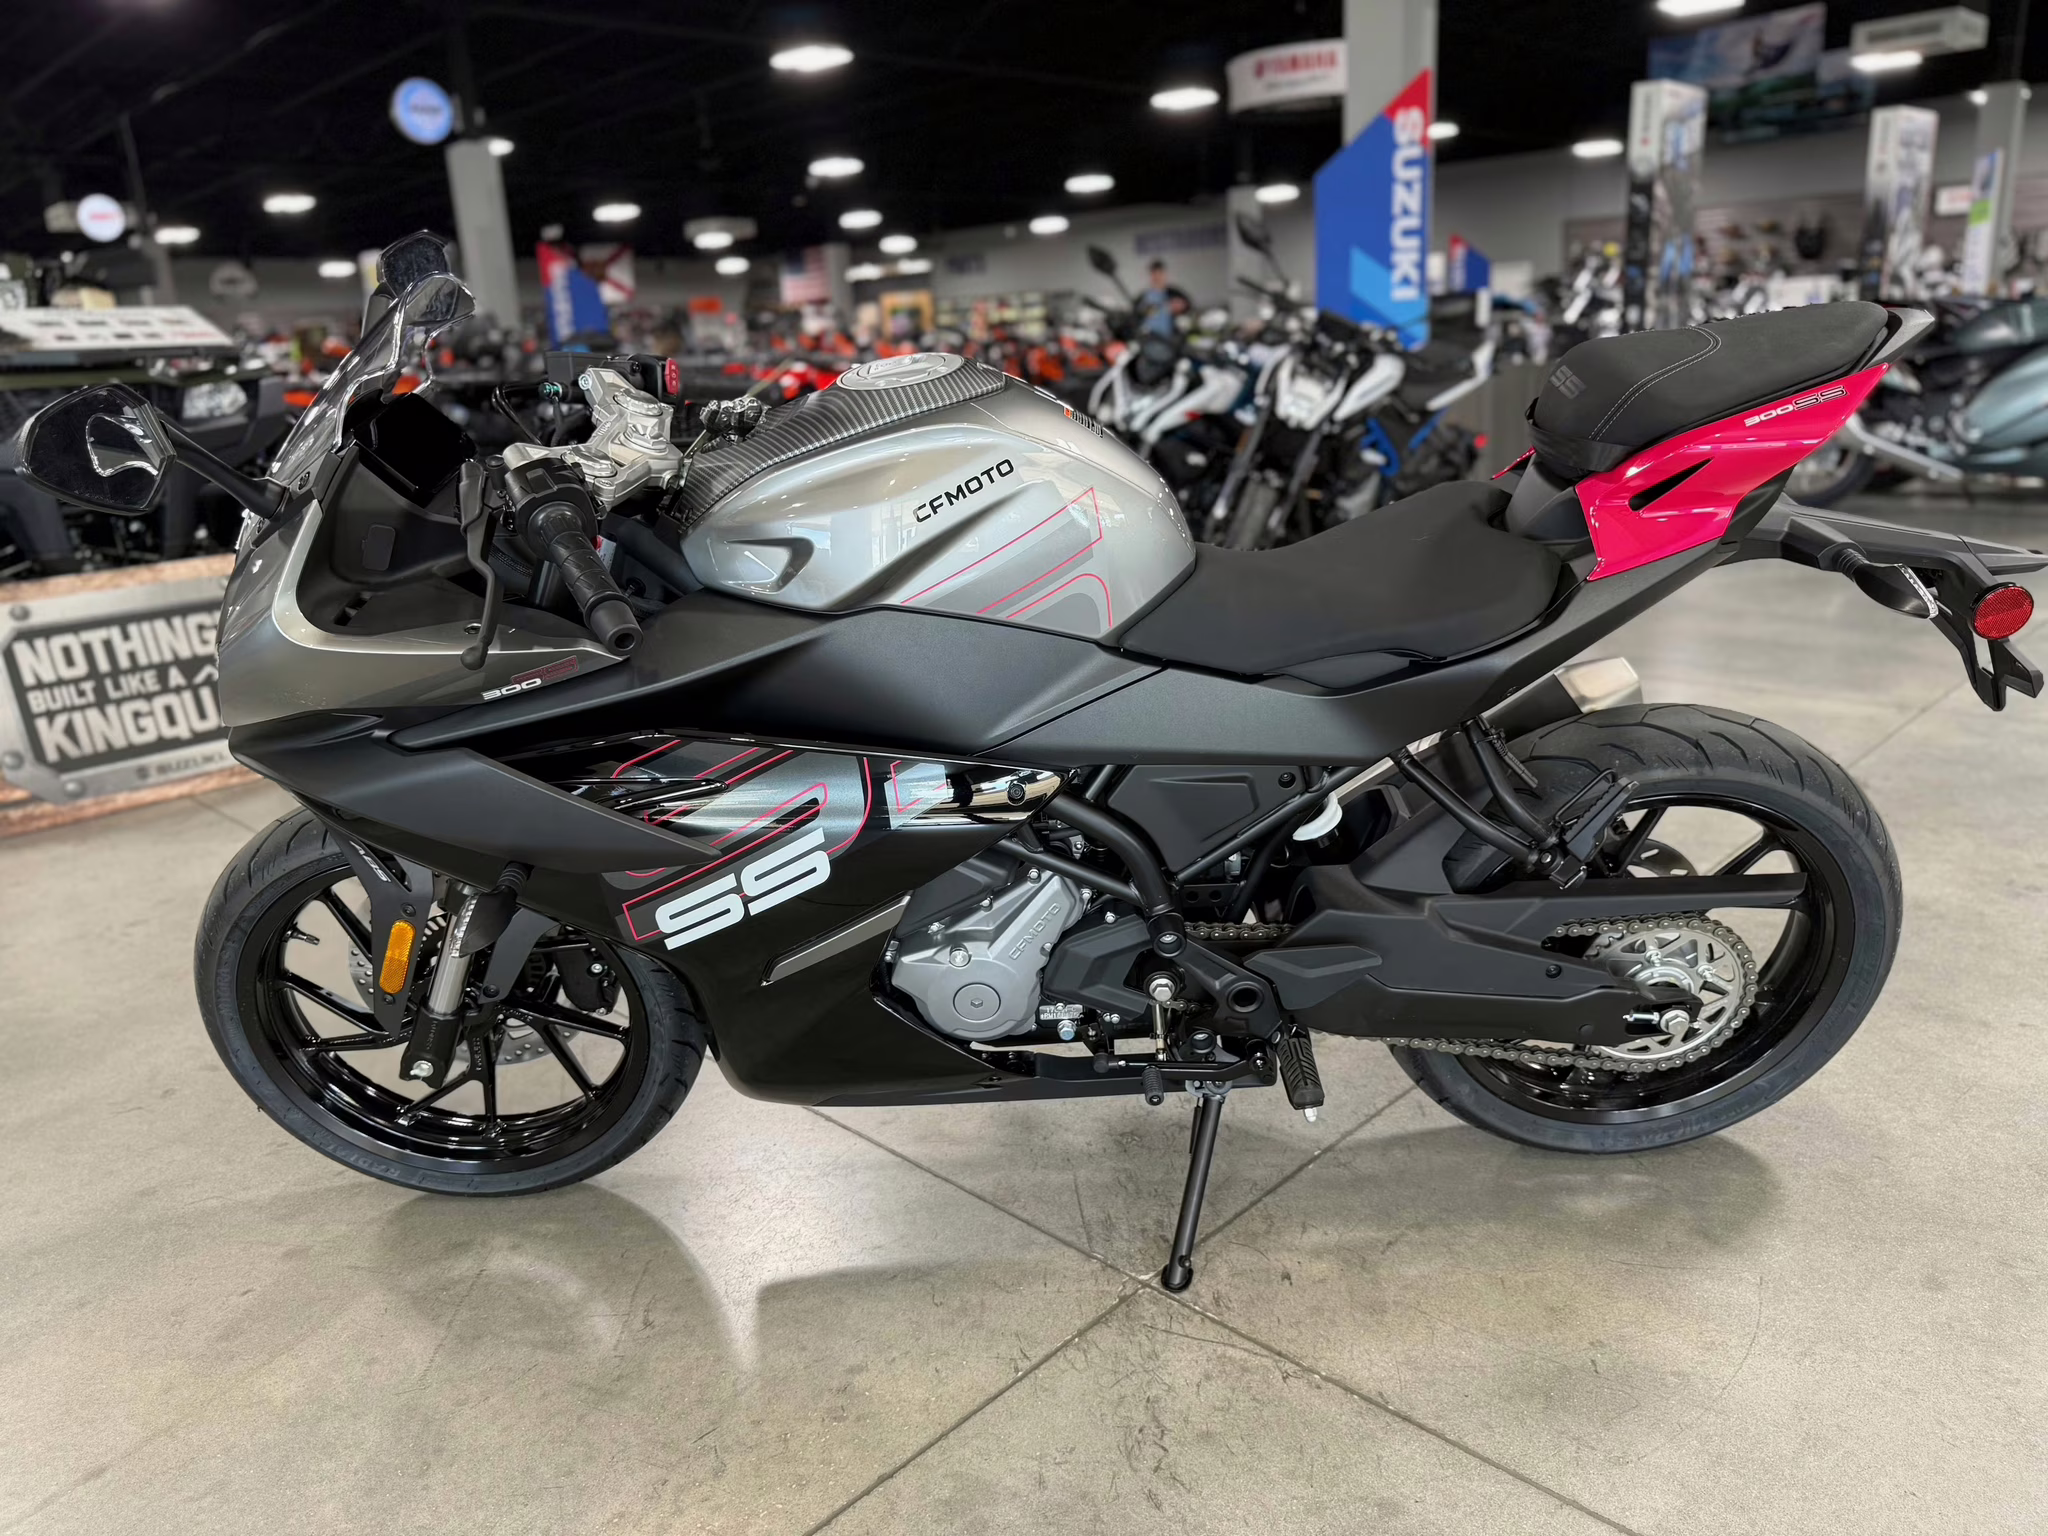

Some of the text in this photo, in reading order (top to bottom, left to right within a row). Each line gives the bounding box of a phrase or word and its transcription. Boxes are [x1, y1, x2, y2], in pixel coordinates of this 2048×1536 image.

[1391, 105, 1425, 302] SUZUKI
[1550, 365, 1587, 400] SS
[912, 458, 1014, 523] CFMOTO
[26, 665, 188, 714] BUILT LIKE A
[34, 685, 221, 763] KINGQU
[349, 840, 392, 883] ABS
[655, 827, 831, 950] SS
[1008, 902, 1061, 960] CFMOTO
